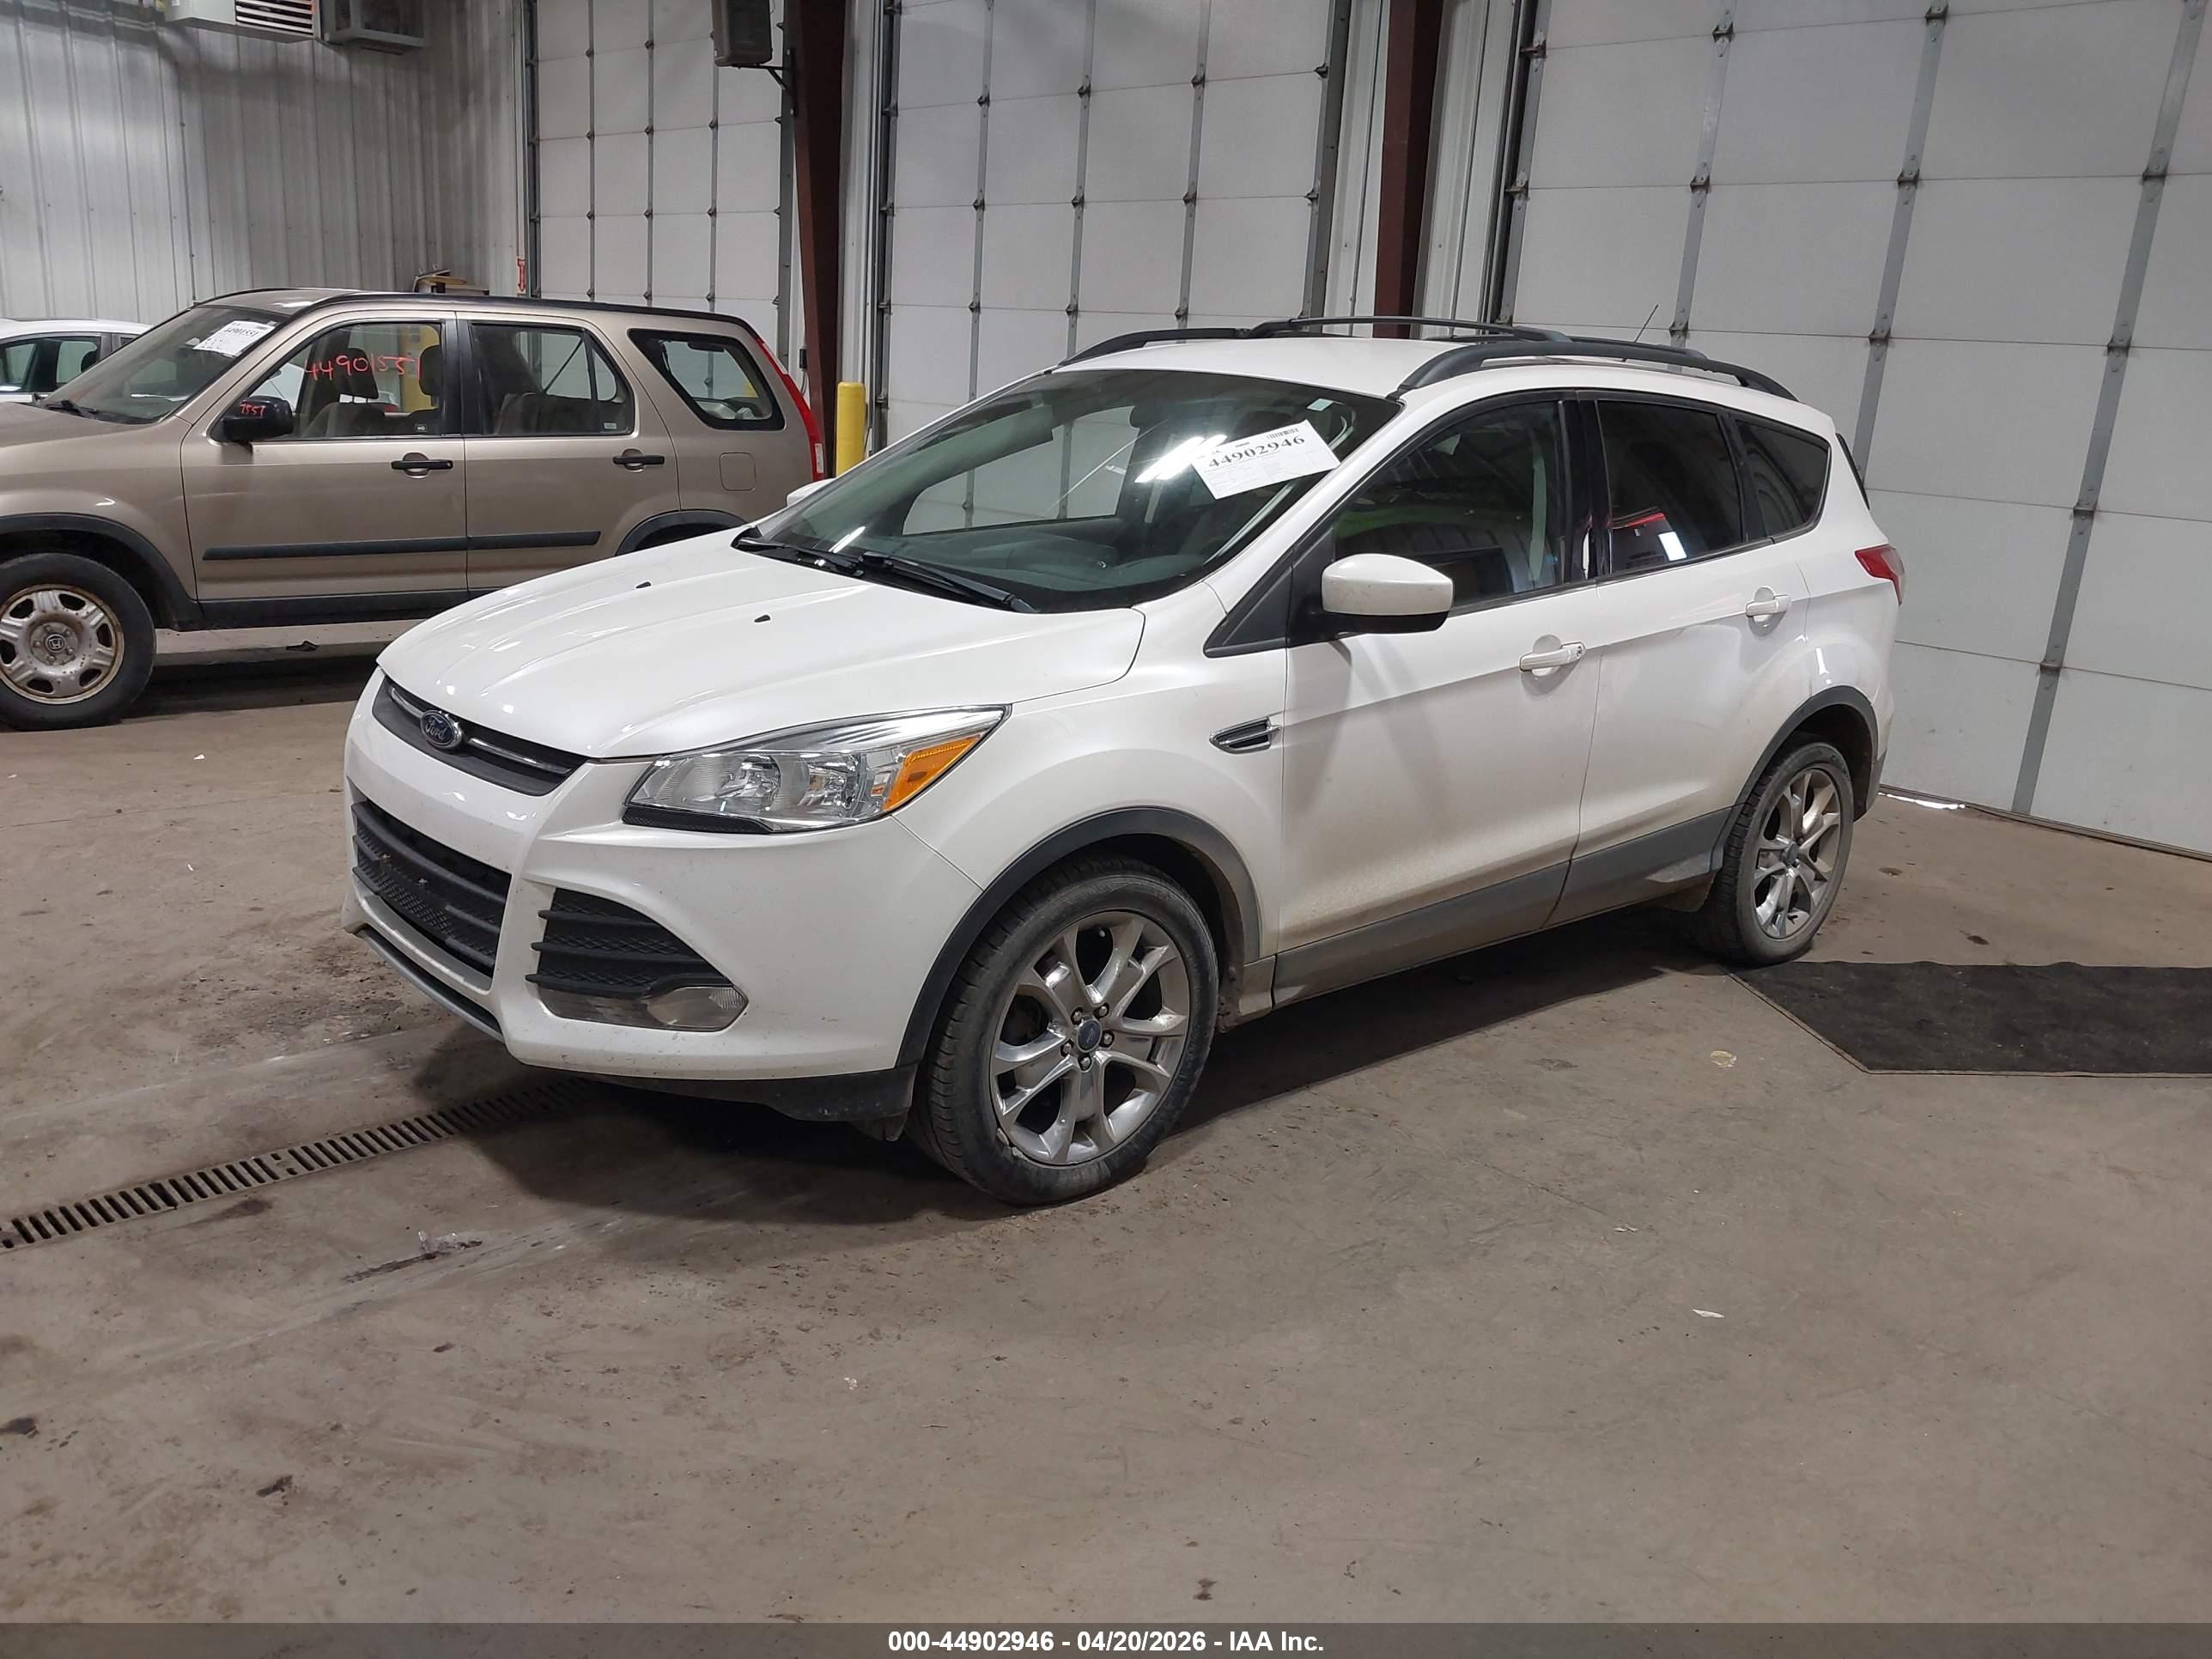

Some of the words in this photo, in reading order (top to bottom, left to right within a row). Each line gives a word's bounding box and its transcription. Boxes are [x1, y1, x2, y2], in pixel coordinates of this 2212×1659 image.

[304, 353, 421, 380] 44901551
[1208, 435, 1305, 468] 44902946
[425, 714, 447, 740] Ford
